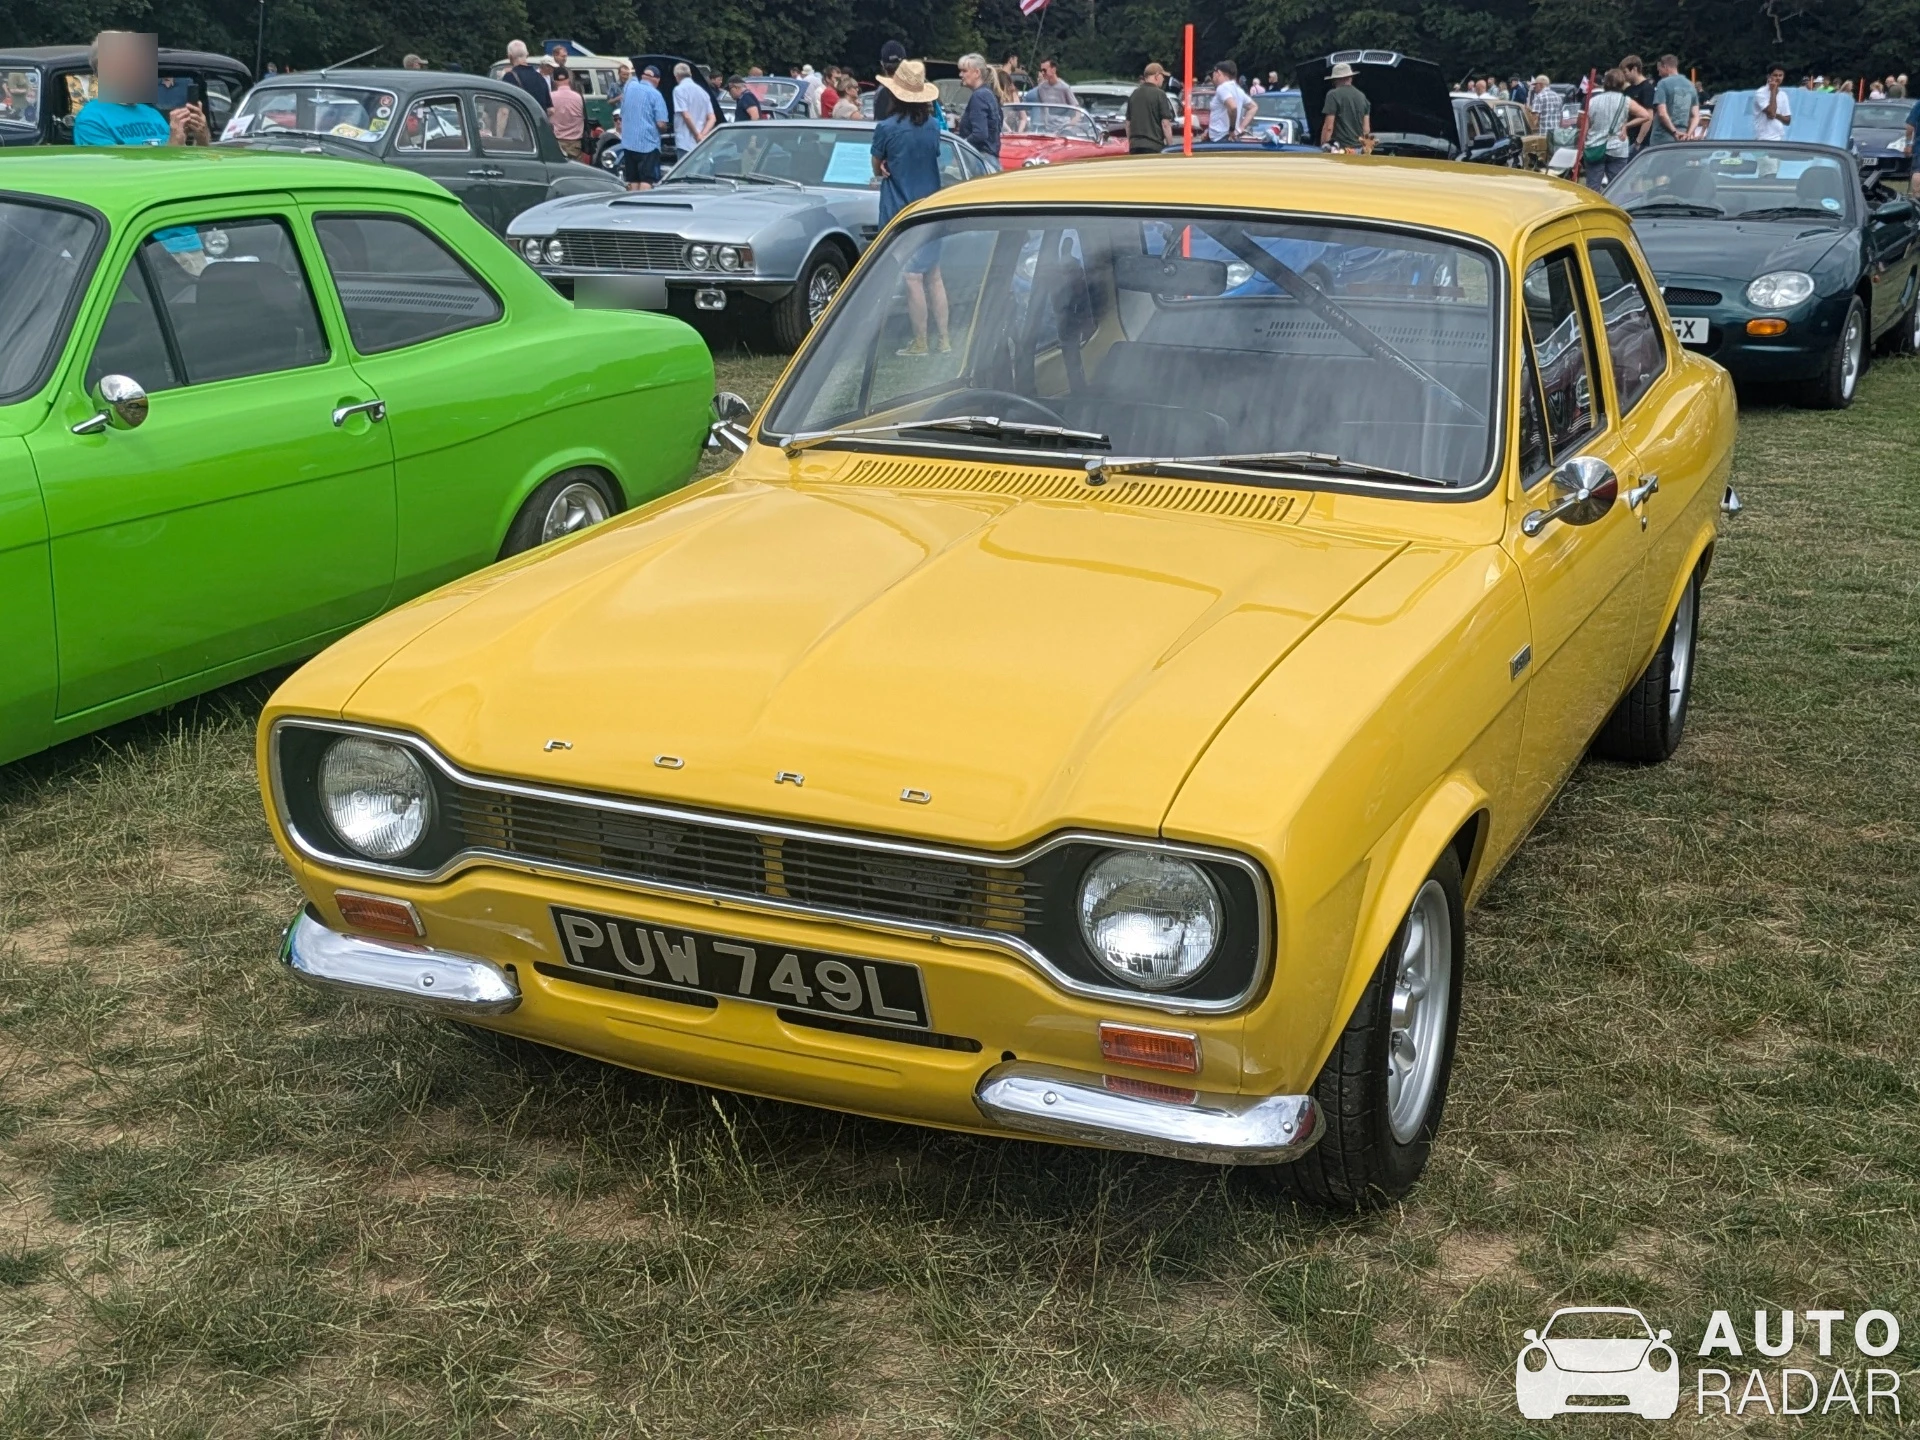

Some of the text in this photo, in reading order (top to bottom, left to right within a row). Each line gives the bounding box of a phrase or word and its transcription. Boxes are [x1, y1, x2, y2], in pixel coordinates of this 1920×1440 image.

[543, 739, 933, 805] FORD
[559, 913, 918, 1022] PUW 749L
